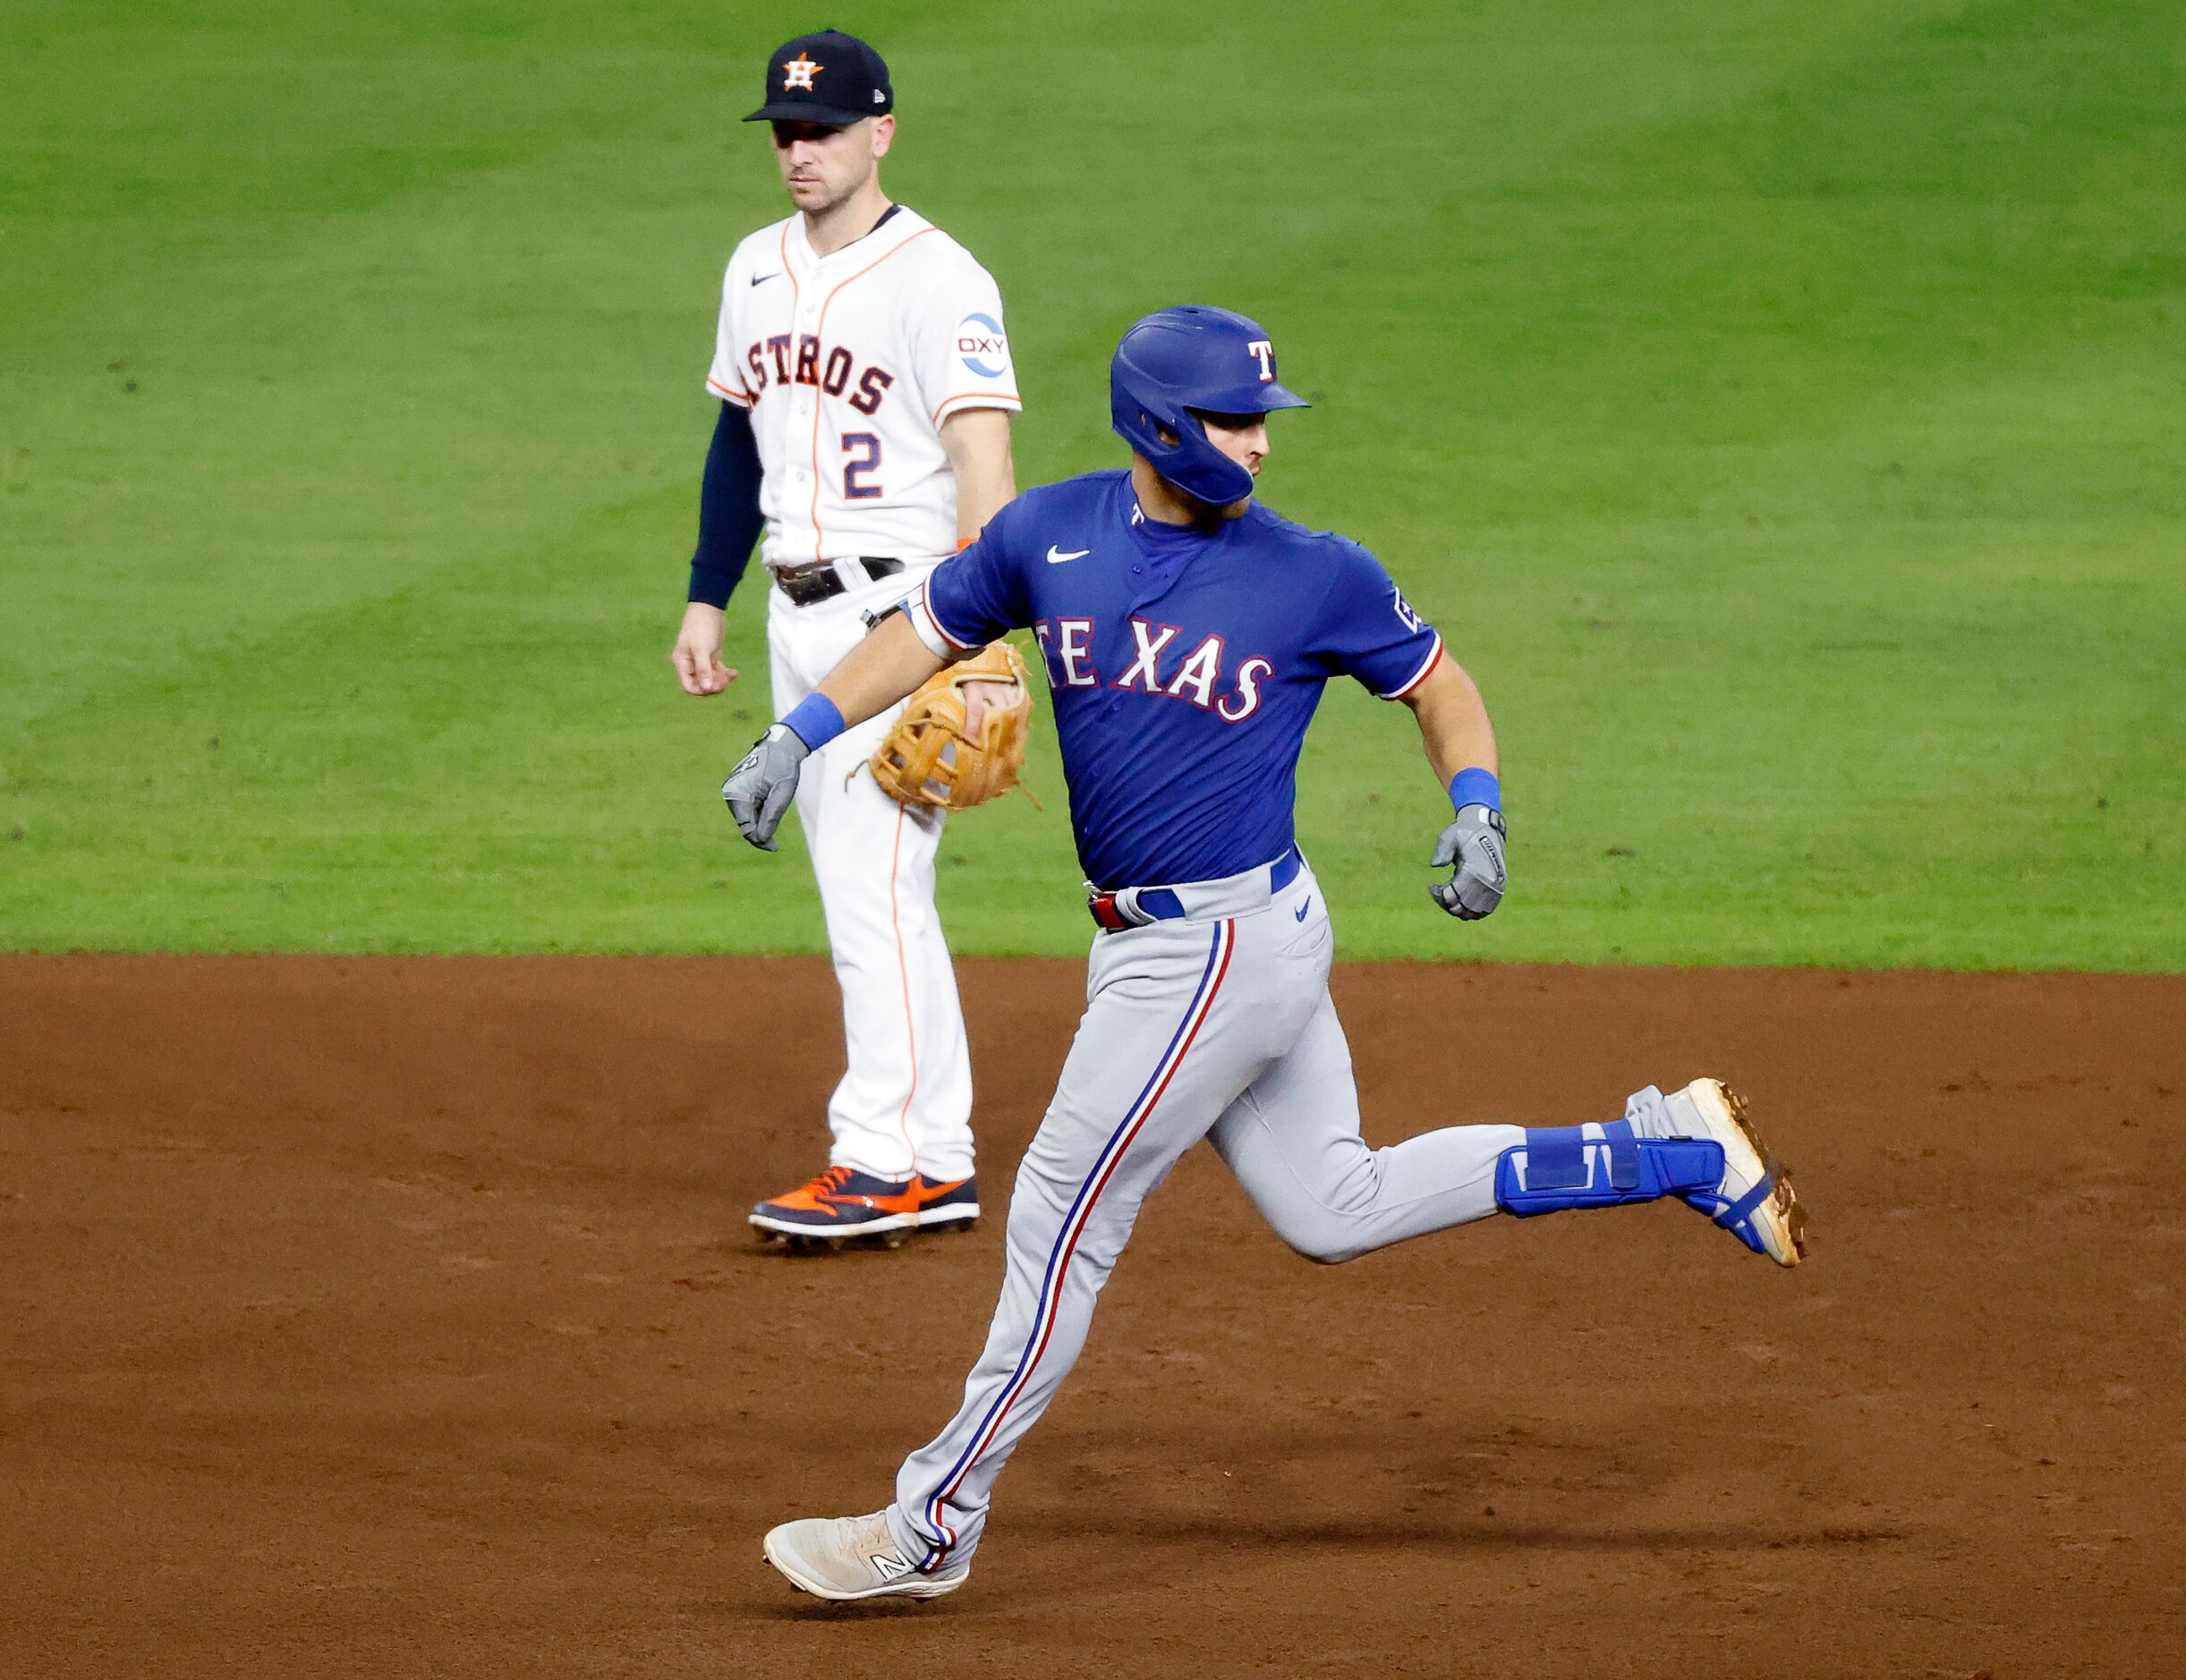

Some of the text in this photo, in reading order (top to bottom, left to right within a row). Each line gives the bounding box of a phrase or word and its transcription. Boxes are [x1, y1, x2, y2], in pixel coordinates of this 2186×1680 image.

[958, 338, 1004, 354] OXY
[1247, 340, 1275, 384] T
[841, 432, 884, 499] 2
